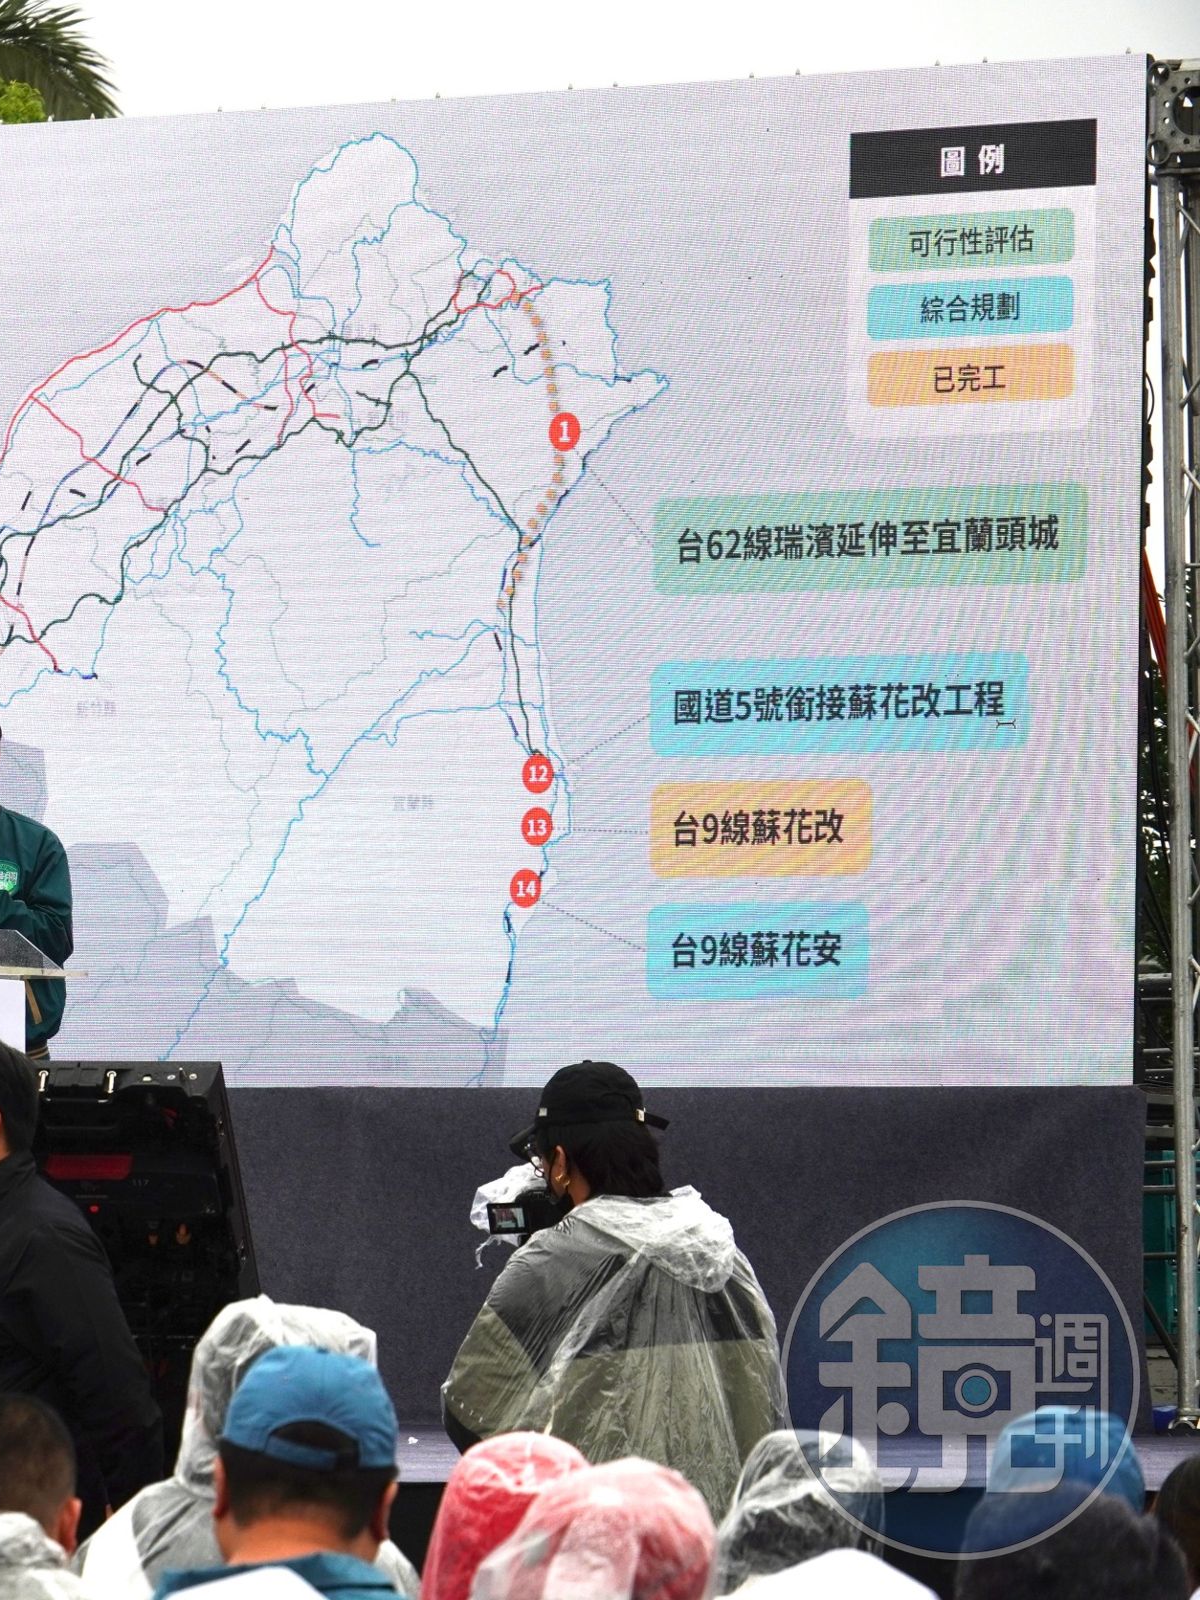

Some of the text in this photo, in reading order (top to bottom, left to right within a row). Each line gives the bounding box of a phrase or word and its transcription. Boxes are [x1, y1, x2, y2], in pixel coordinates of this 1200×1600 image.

[940, 143, 1005, 178] 圖例
[908, 224, 1035, 258] 可行性評估
[920, 291, 1021, 324] 綜合規劃
[933, 364, 1006, 393] 已完工
[558, 421, 570, 443] 1
[677, 514, 1059, 564] 台62線瑞濱延伸至宜蘭頭城
[673, 680, 1005, 725] 國道5號銜接蘇花改工程
[528, 765, 549, 783] 12
[527, 819, 547, 837] 13
[673, 808, 844, 847] 台9線蘇花改
[516, 879, 537, 898] 14
[671, 930, 842, 969] 台9線蘇花安
